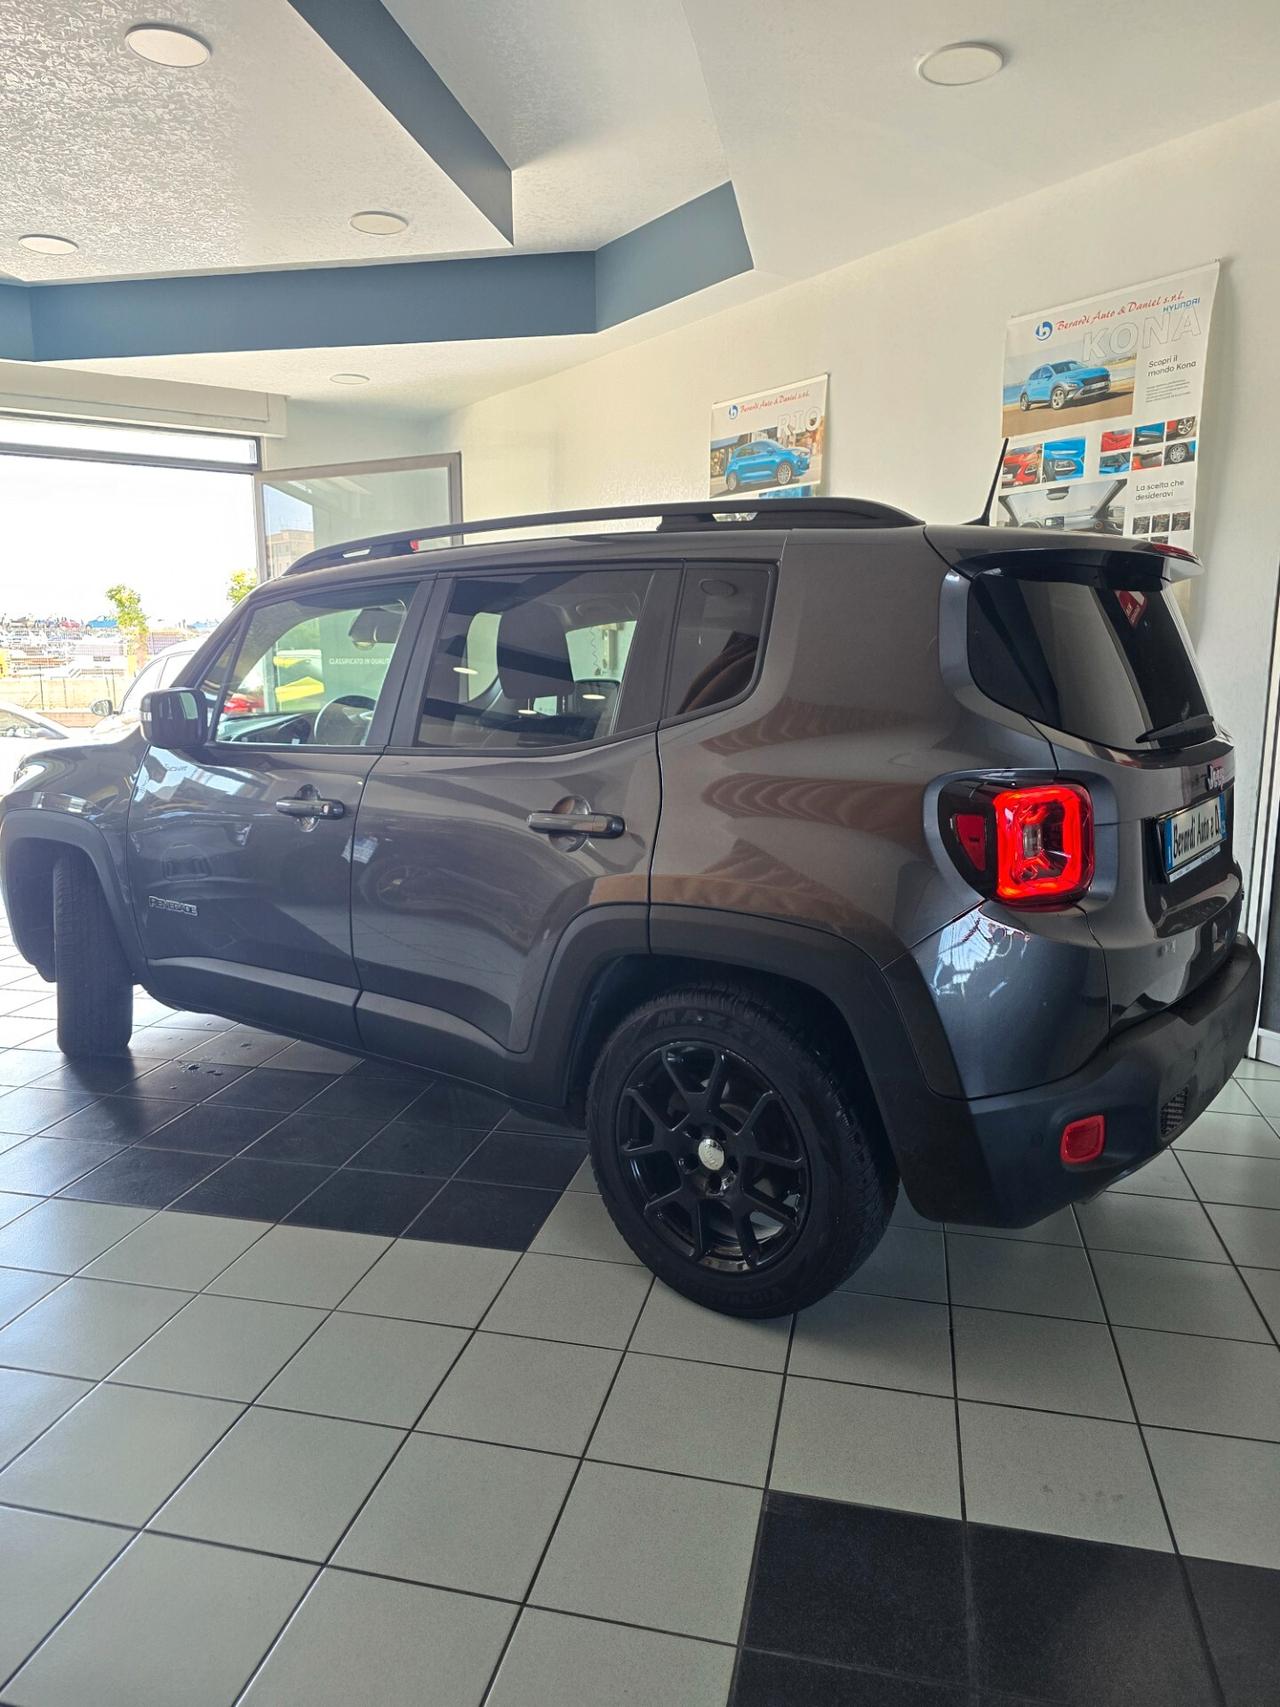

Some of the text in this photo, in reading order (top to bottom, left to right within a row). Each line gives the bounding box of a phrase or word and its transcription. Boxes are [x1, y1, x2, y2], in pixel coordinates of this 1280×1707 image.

[1090, 309, 1116, 325] Auto
[1117, 306, 1126, 316] &
[1128, 296, 1162, 313] Daniel
[1081, 307, 1202, 362] KONA
[1147, 361, 1197, 377] mondo Kona
[1148, 354, 1178, 368] Scopri il
[1136, 484, 1146, 492] La
[1147, 482, 1169, 491] scelta
[1135, 491, 1174, 501] desideravi
[1207, 764, 1225, 791] Jeep
